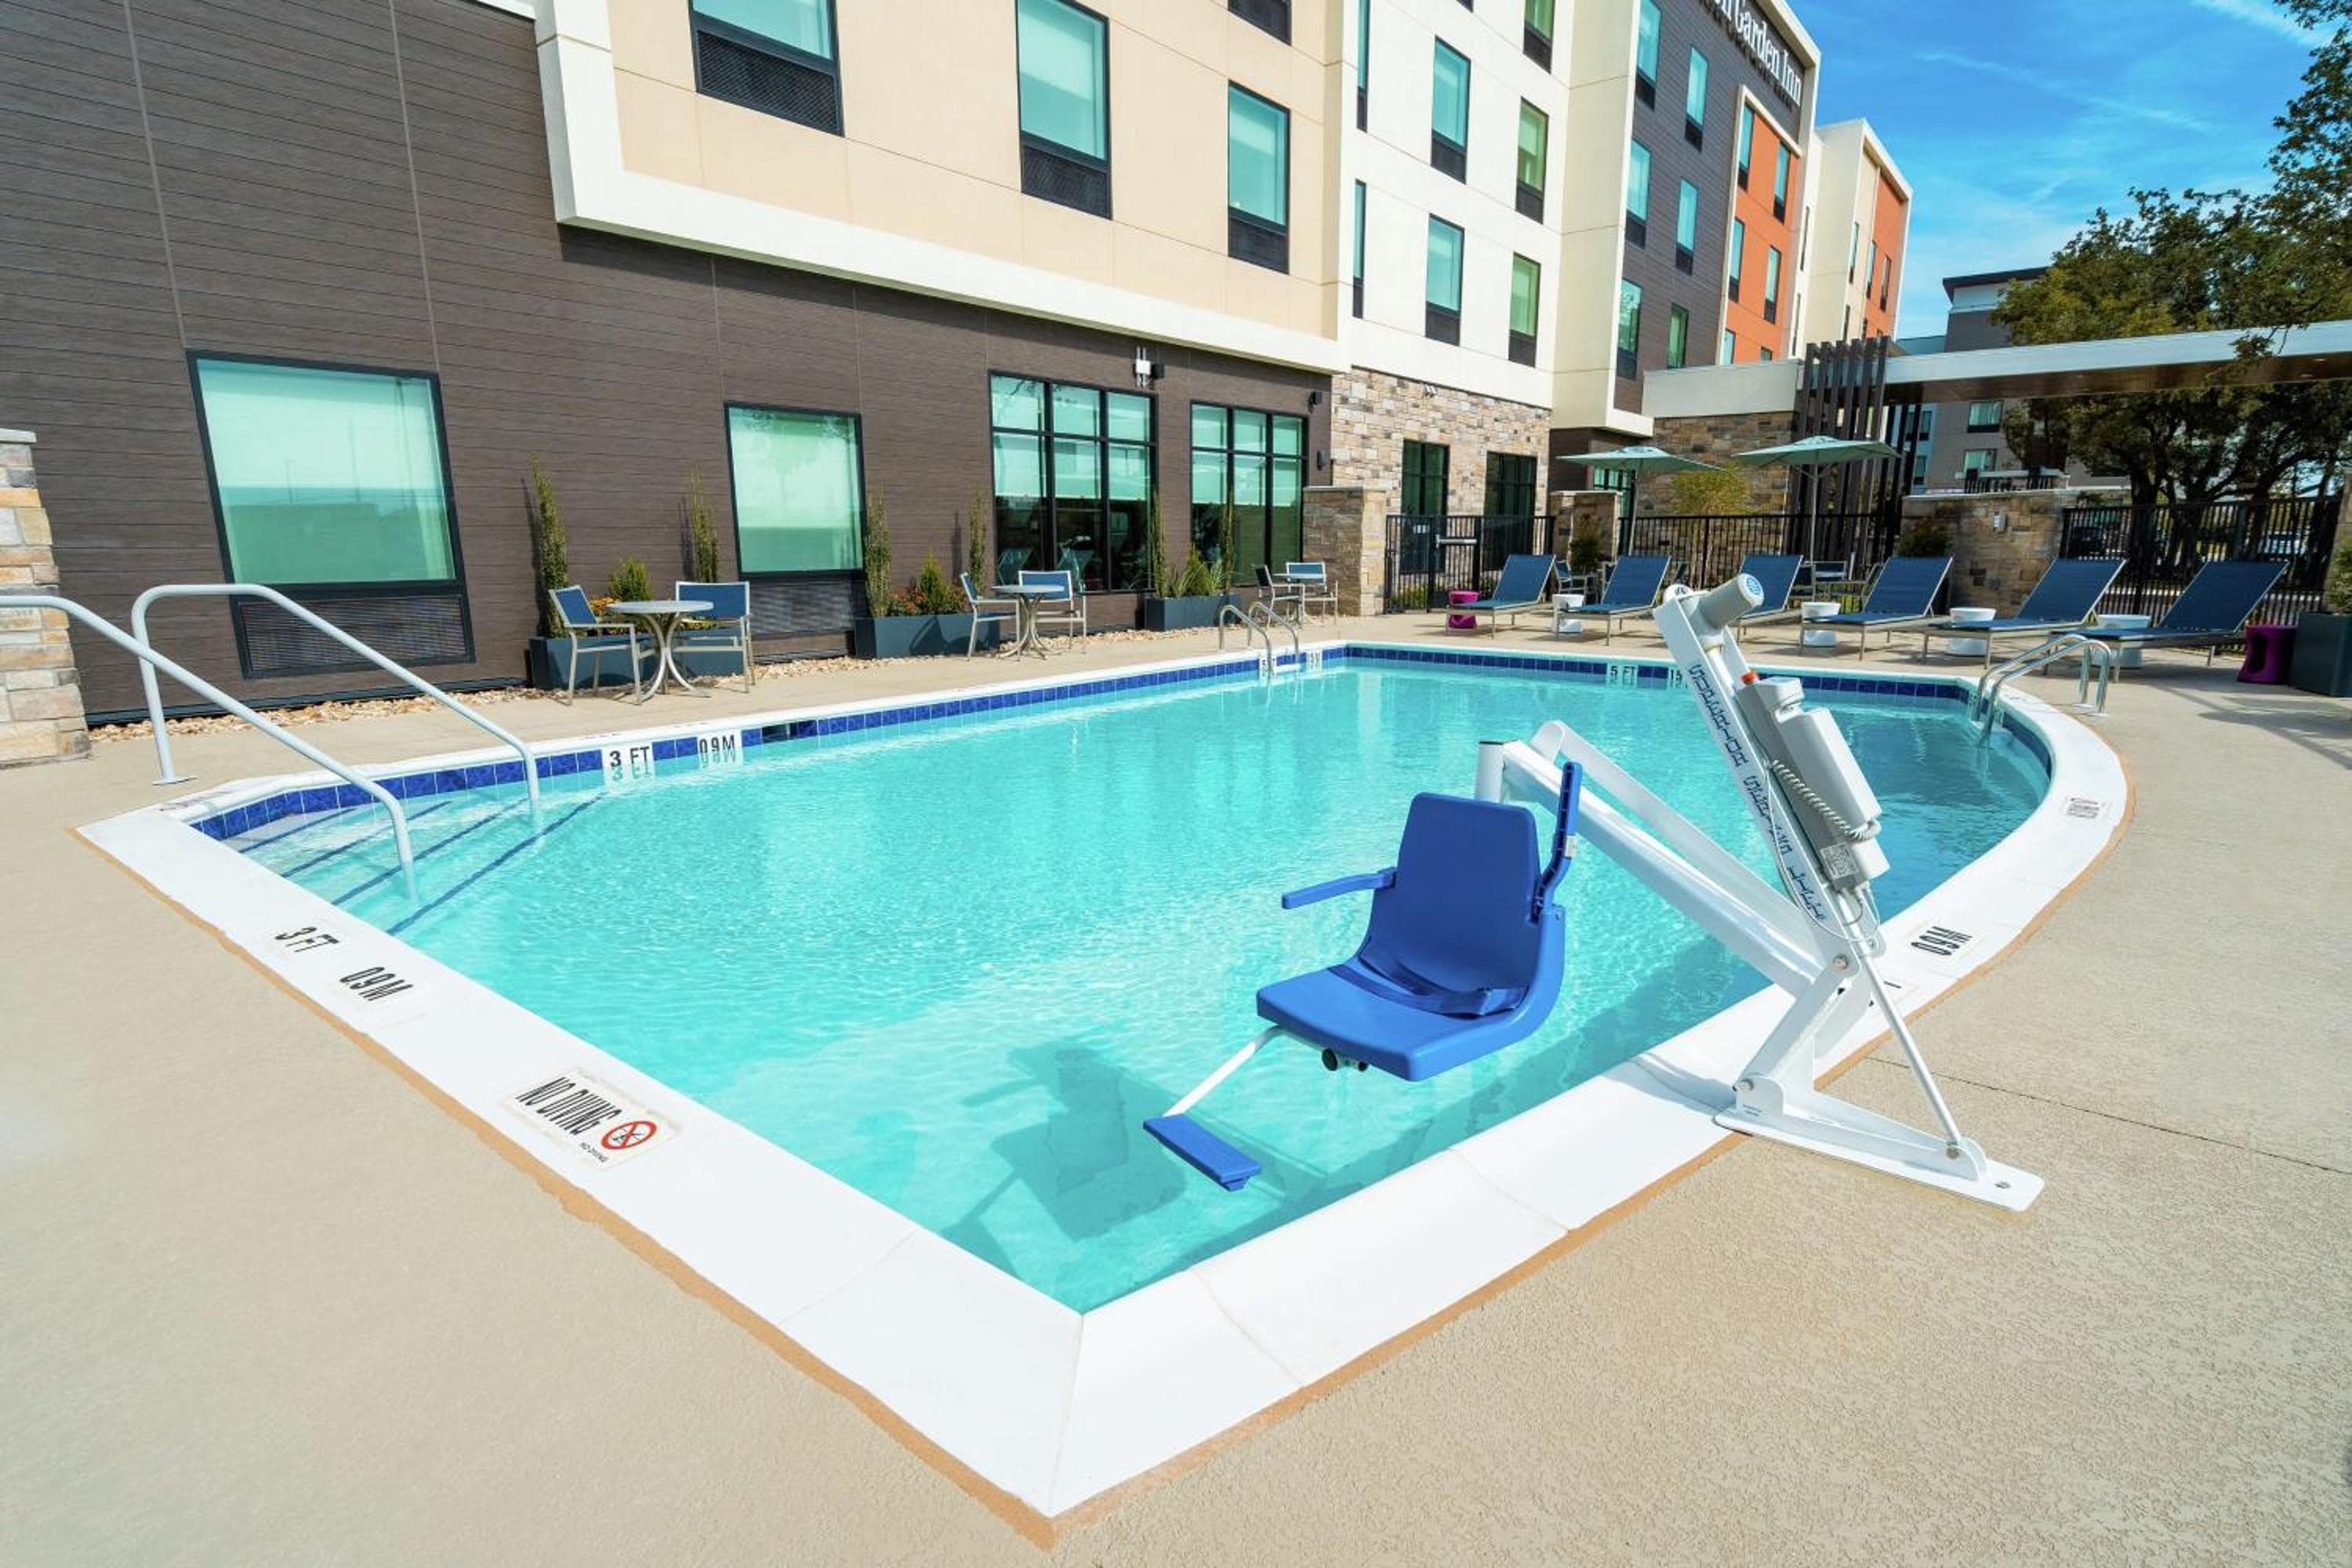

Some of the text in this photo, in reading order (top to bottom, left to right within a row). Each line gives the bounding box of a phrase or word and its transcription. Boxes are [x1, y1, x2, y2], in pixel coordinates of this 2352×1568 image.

[1734, 0, 1802, 107] Garden Inn
[1610, 665, 1635, 679] 5 FT
[1688, 664, 1749, 768] SUPERIOR
[609, 746, 650, 768] 3 FT
[275, 926, 340, 953] 3 FT
[514, 1076, 622, 1136] NO DIVING
